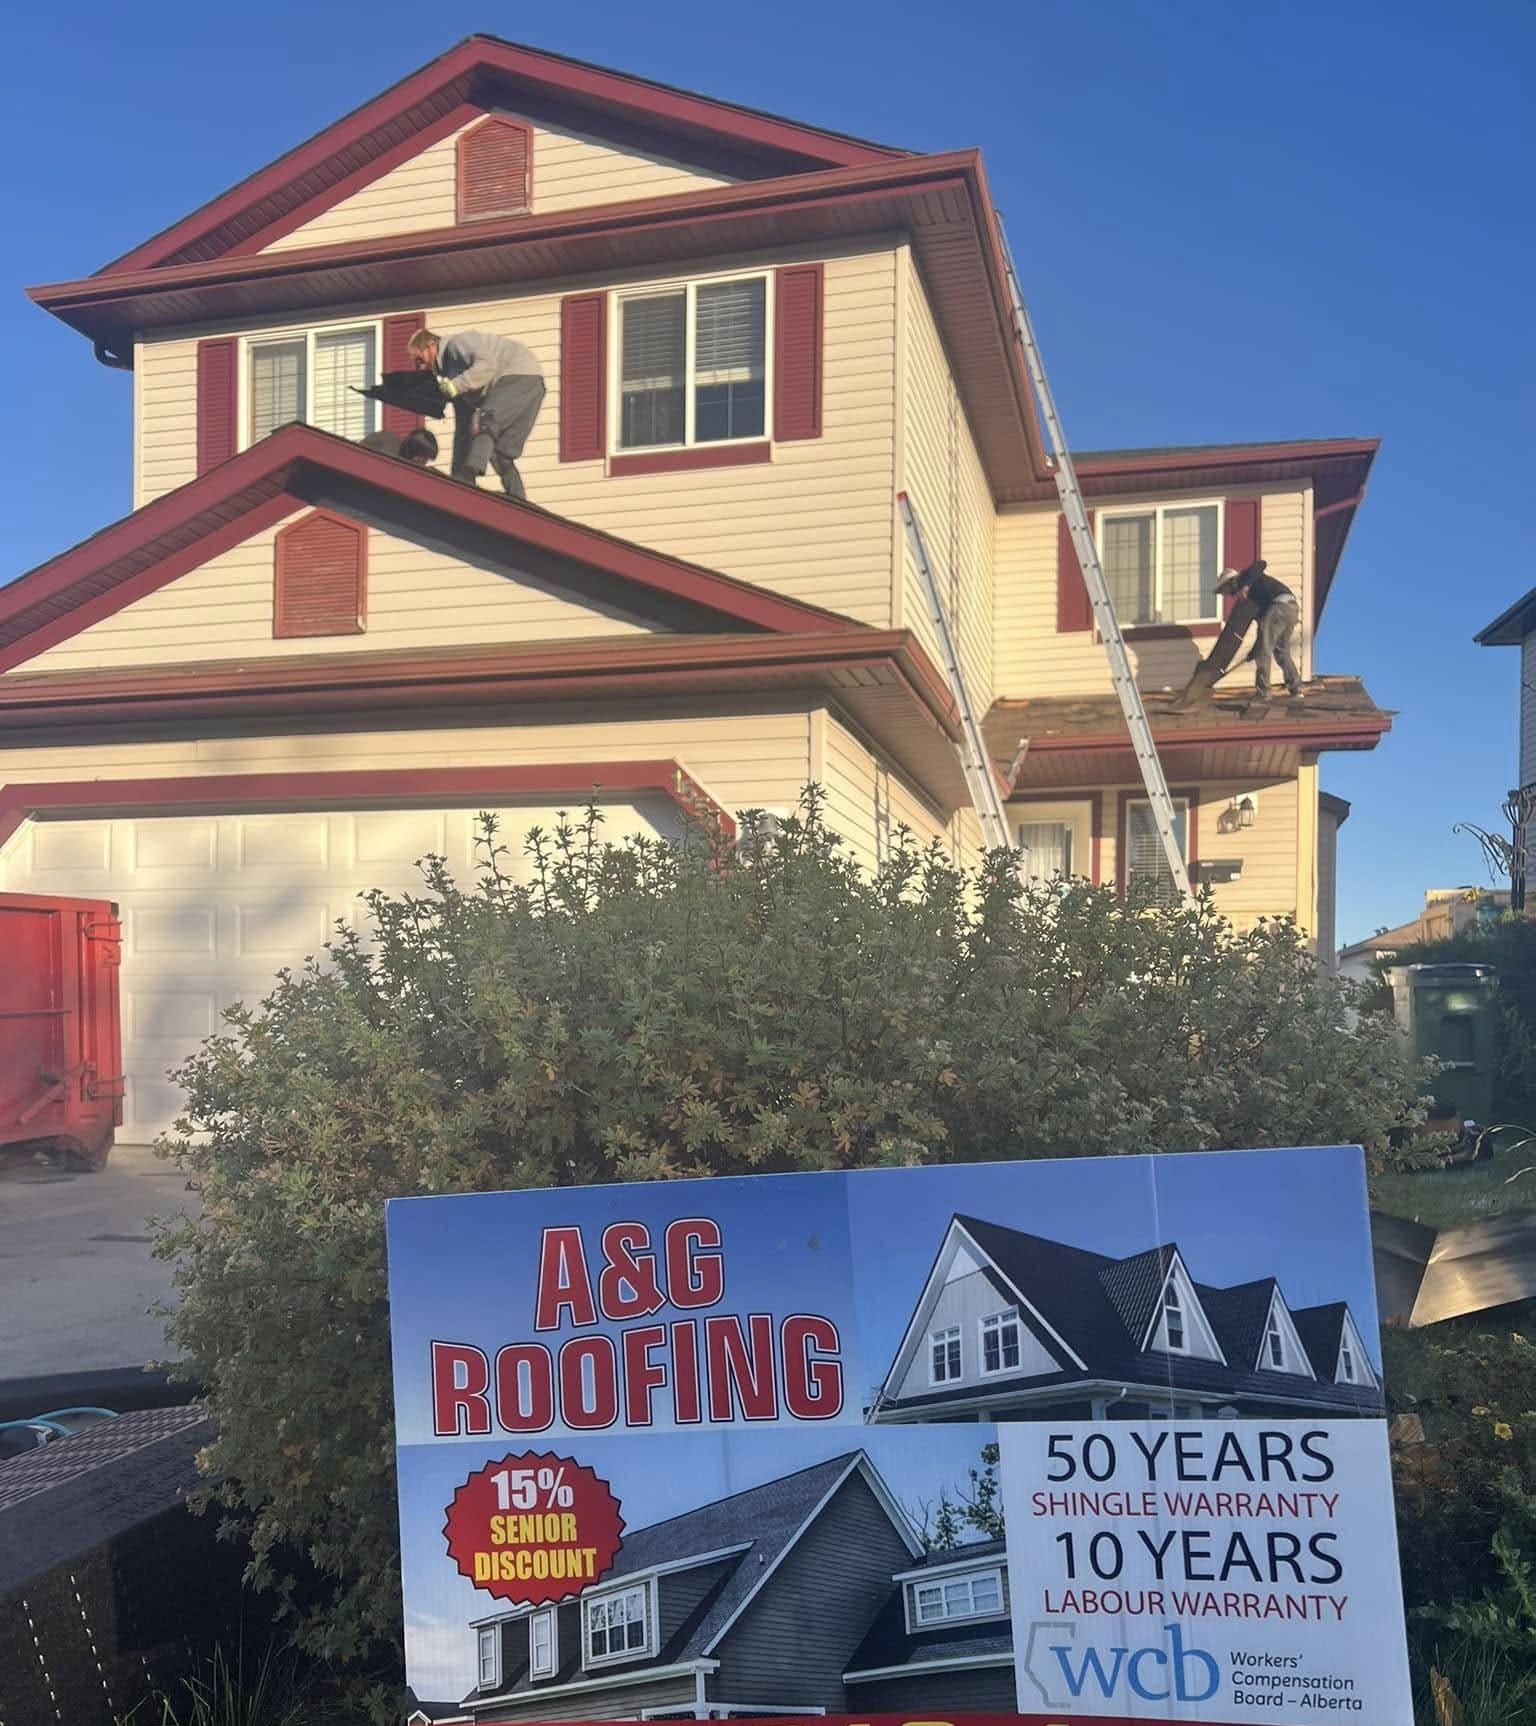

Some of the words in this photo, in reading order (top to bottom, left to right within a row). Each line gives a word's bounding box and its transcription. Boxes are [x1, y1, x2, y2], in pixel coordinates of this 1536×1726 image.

[534, 1217, 726, 1333] A&G
[430, 1314, 845, 1437] ROOFING
[1046, 1433, 1117, 1482] 50
[1129, 1430, 1335, 1483] YEARS
[490, 1467, 575, 1510] 15%
[1032, 1491, 1158, 1517] SHINGLE
[1164, 1491, 1340, 1518] WARRANTY
[489, 1513, 578, 1544] SENIOR
[474, 1547, 598, 1582] DISCOUNT
[1055, 1530, 1124, 1581] 10
[1137, 1530, 1344, 1585] YEARS
[1044, 1589, 1166, 1616] LABOUR
[1173, 1591, 1349, 1621] WARRANTY
[1048, 1622, 1221, 1703] wcb
[1231, 1671, 1354, 1691] Compensation
[1233, 1690, 1284, 1708] Board
[1300, 1692, 1363, 1711] Alberta
